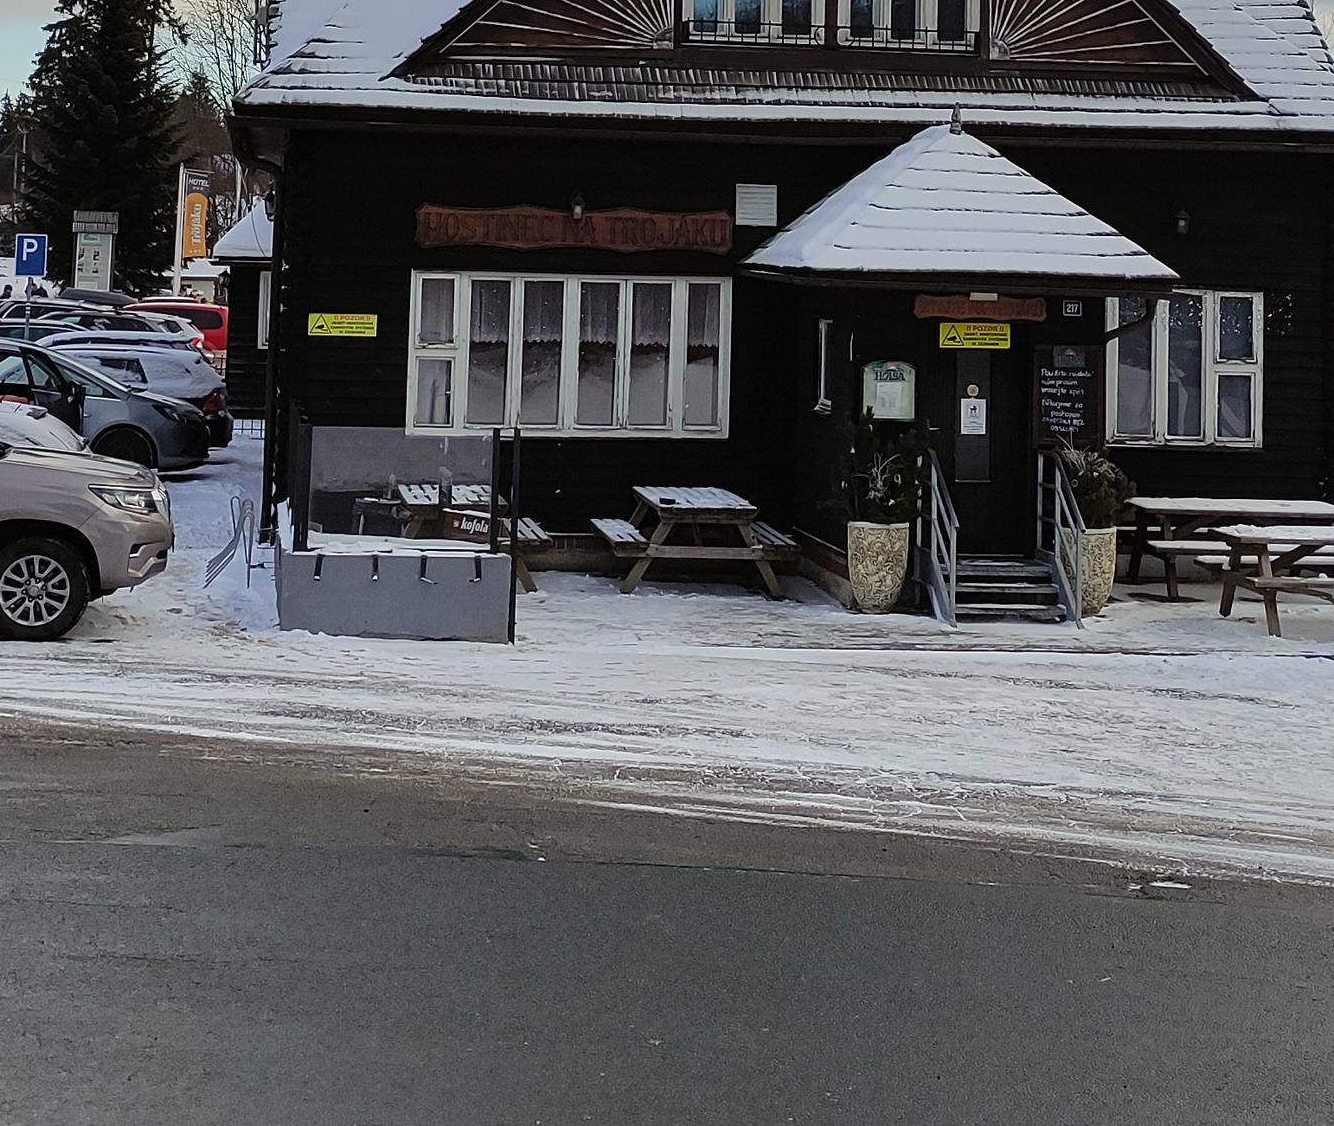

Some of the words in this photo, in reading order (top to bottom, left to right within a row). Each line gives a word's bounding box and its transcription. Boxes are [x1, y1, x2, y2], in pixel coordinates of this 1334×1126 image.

[188, 177, 209, 187] HOTEL
[425, 212, 555, 242] HOSTINEC
[561, 215, 597, 243] NA
[22, 238, 38, 261] P
[1066, 303, 1079, 313] 217
[875, 369, 906, 382] HOLBA
[460, 516, 488, 534] kofola
